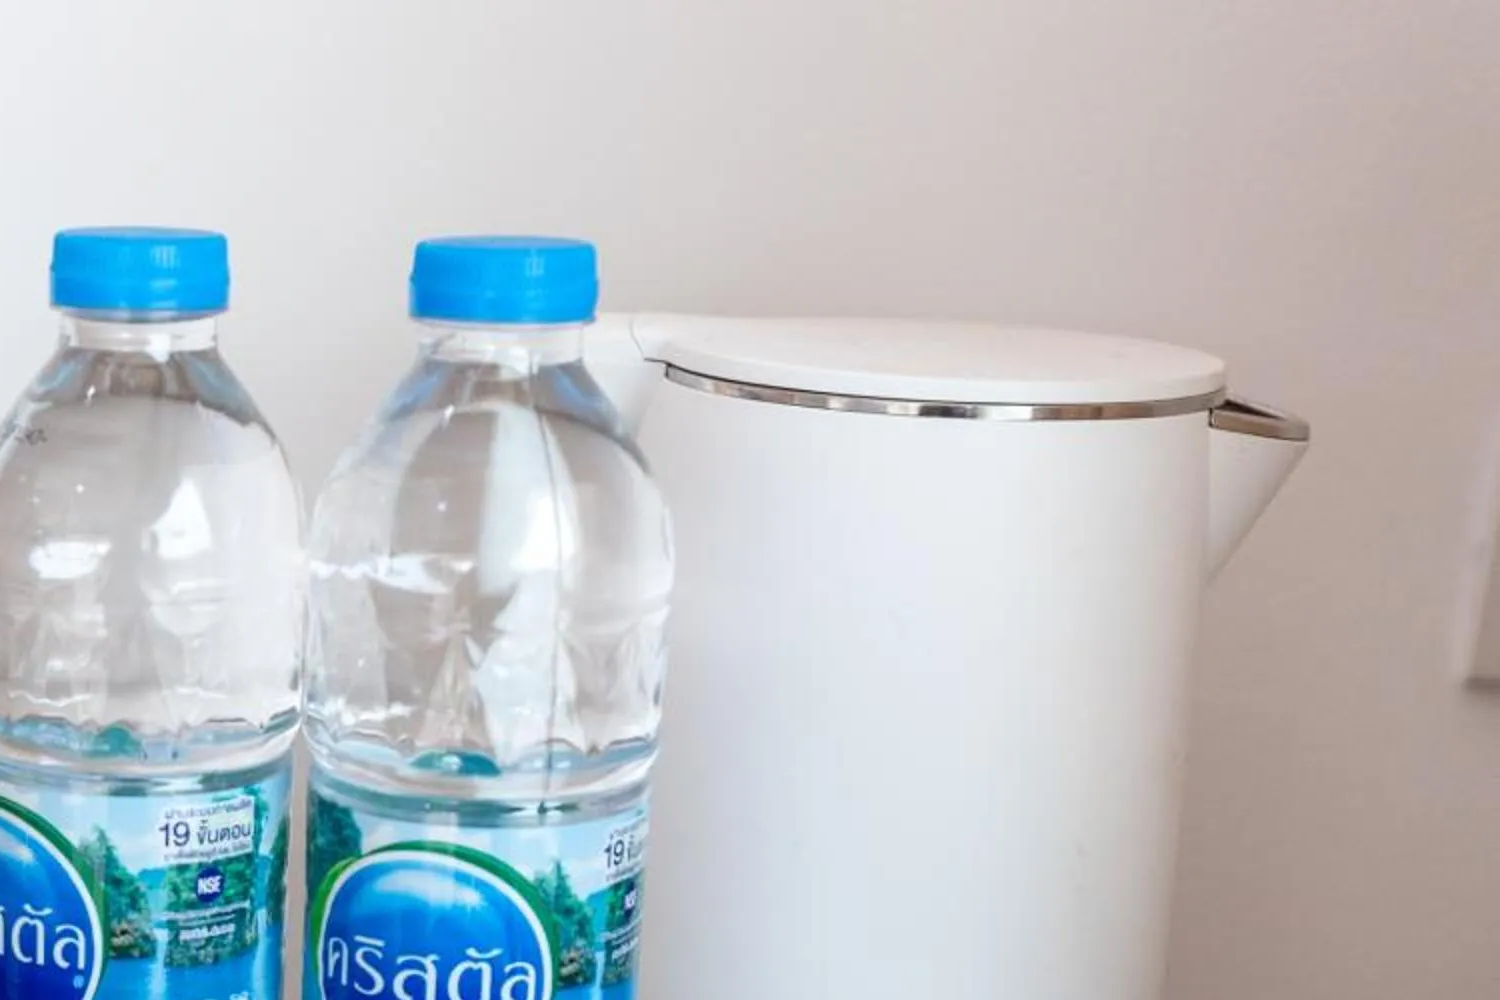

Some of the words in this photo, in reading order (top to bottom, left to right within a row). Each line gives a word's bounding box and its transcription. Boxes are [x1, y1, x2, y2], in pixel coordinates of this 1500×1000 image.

[158, 820, 191, 847] 19
[196, 818, 252, 846] ขั้นตอน
[603, 839, 625, 869] 19
